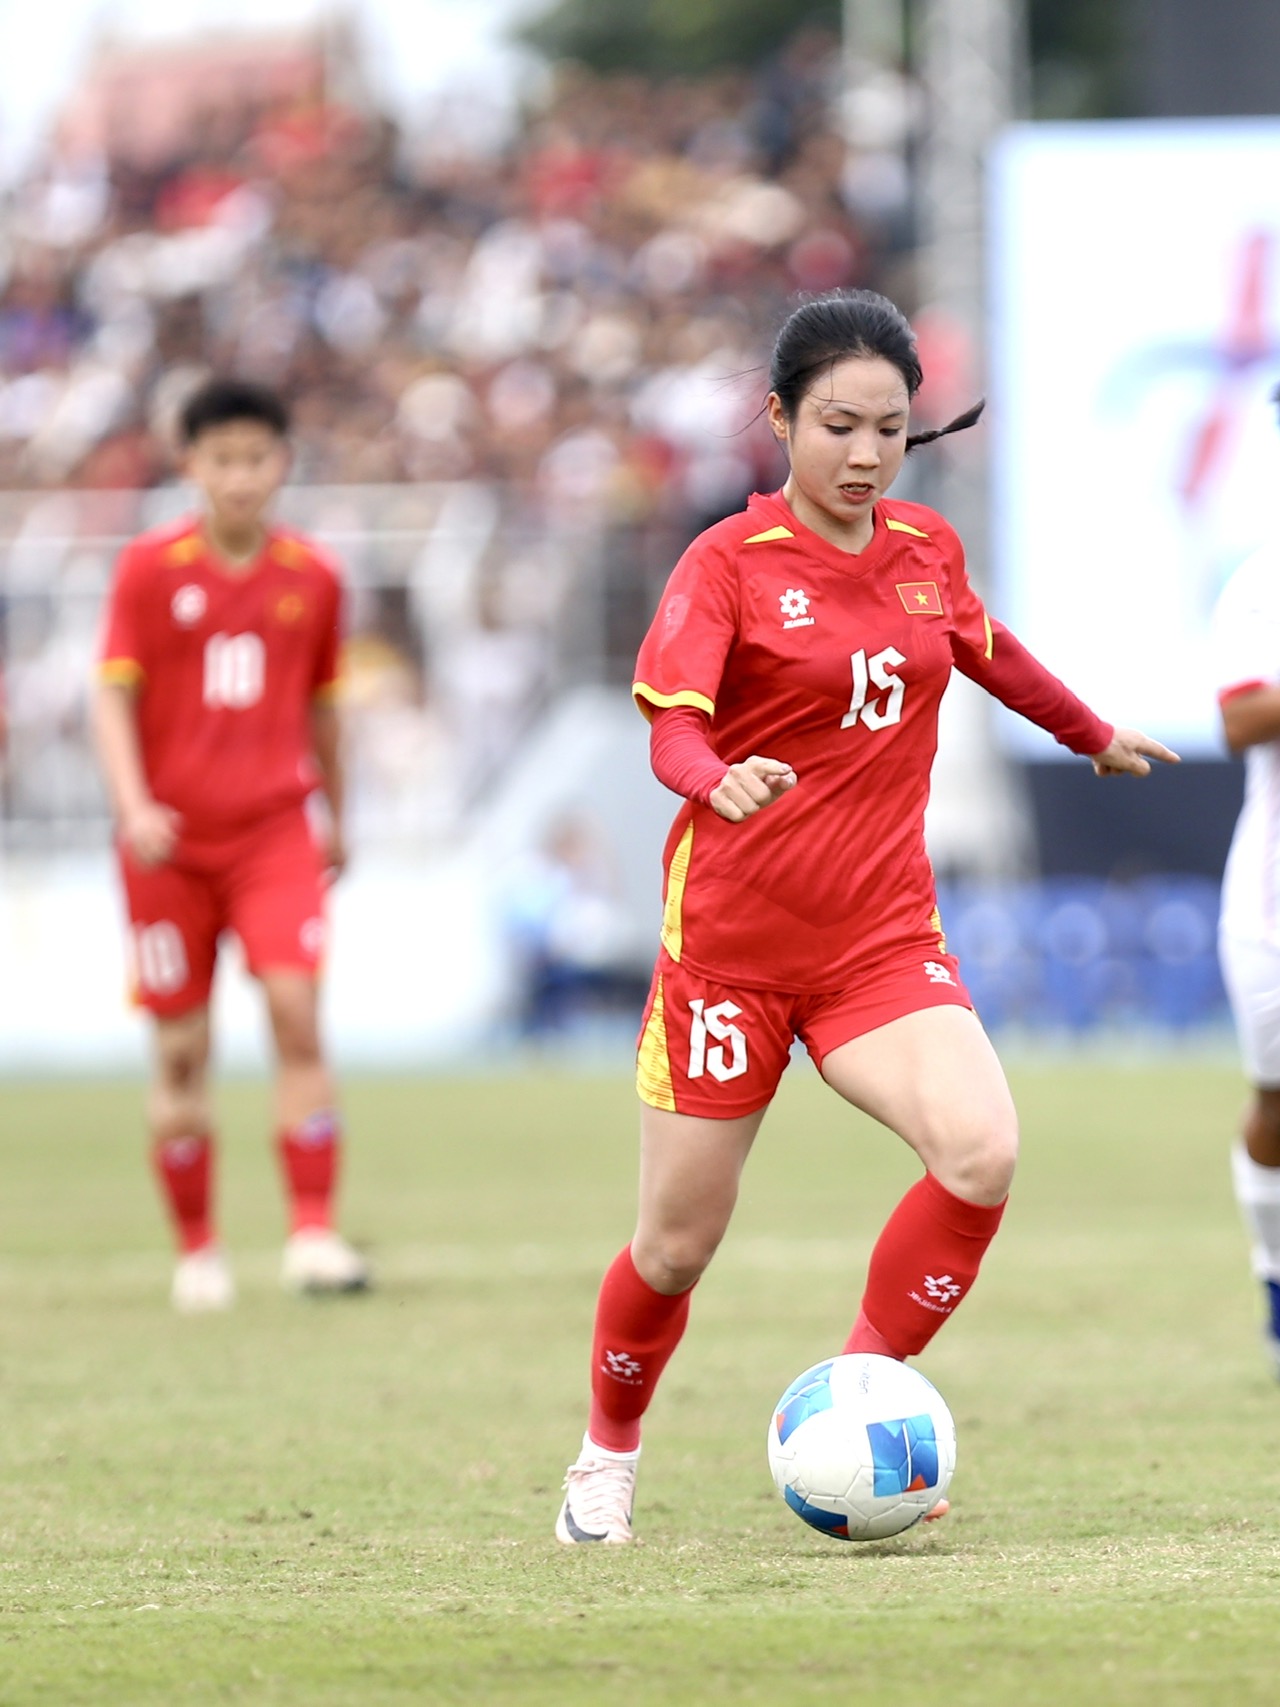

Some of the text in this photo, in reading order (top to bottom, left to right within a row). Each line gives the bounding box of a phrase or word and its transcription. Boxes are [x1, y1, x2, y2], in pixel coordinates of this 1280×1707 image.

[202, 631, 266, 710] 10
[839, 645, 907, 732] 15
[138, 919, 189, 996] 10
[686, 998, 749, 1083] 15
